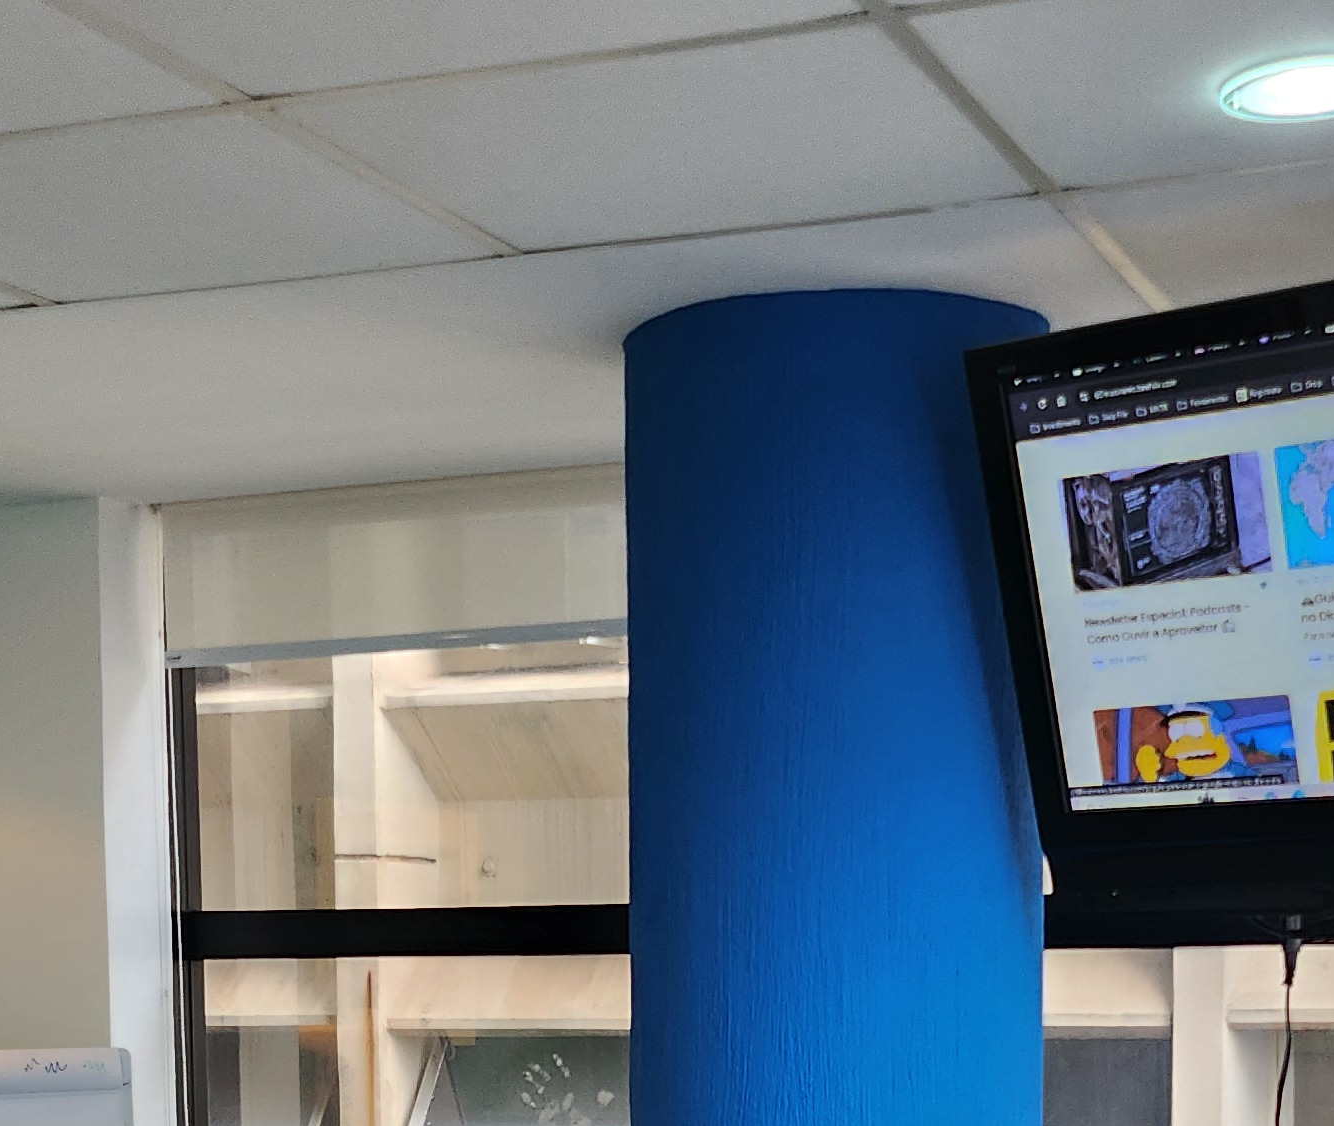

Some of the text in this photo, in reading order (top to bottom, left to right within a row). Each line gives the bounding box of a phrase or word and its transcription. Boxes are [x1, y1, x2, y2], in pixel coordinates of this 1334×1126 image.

[1085, 613, 1138, 629] Newsletter
[1190, 602, 1242, 617] Podcasts
[1087, 630, 1120, 645] Como
